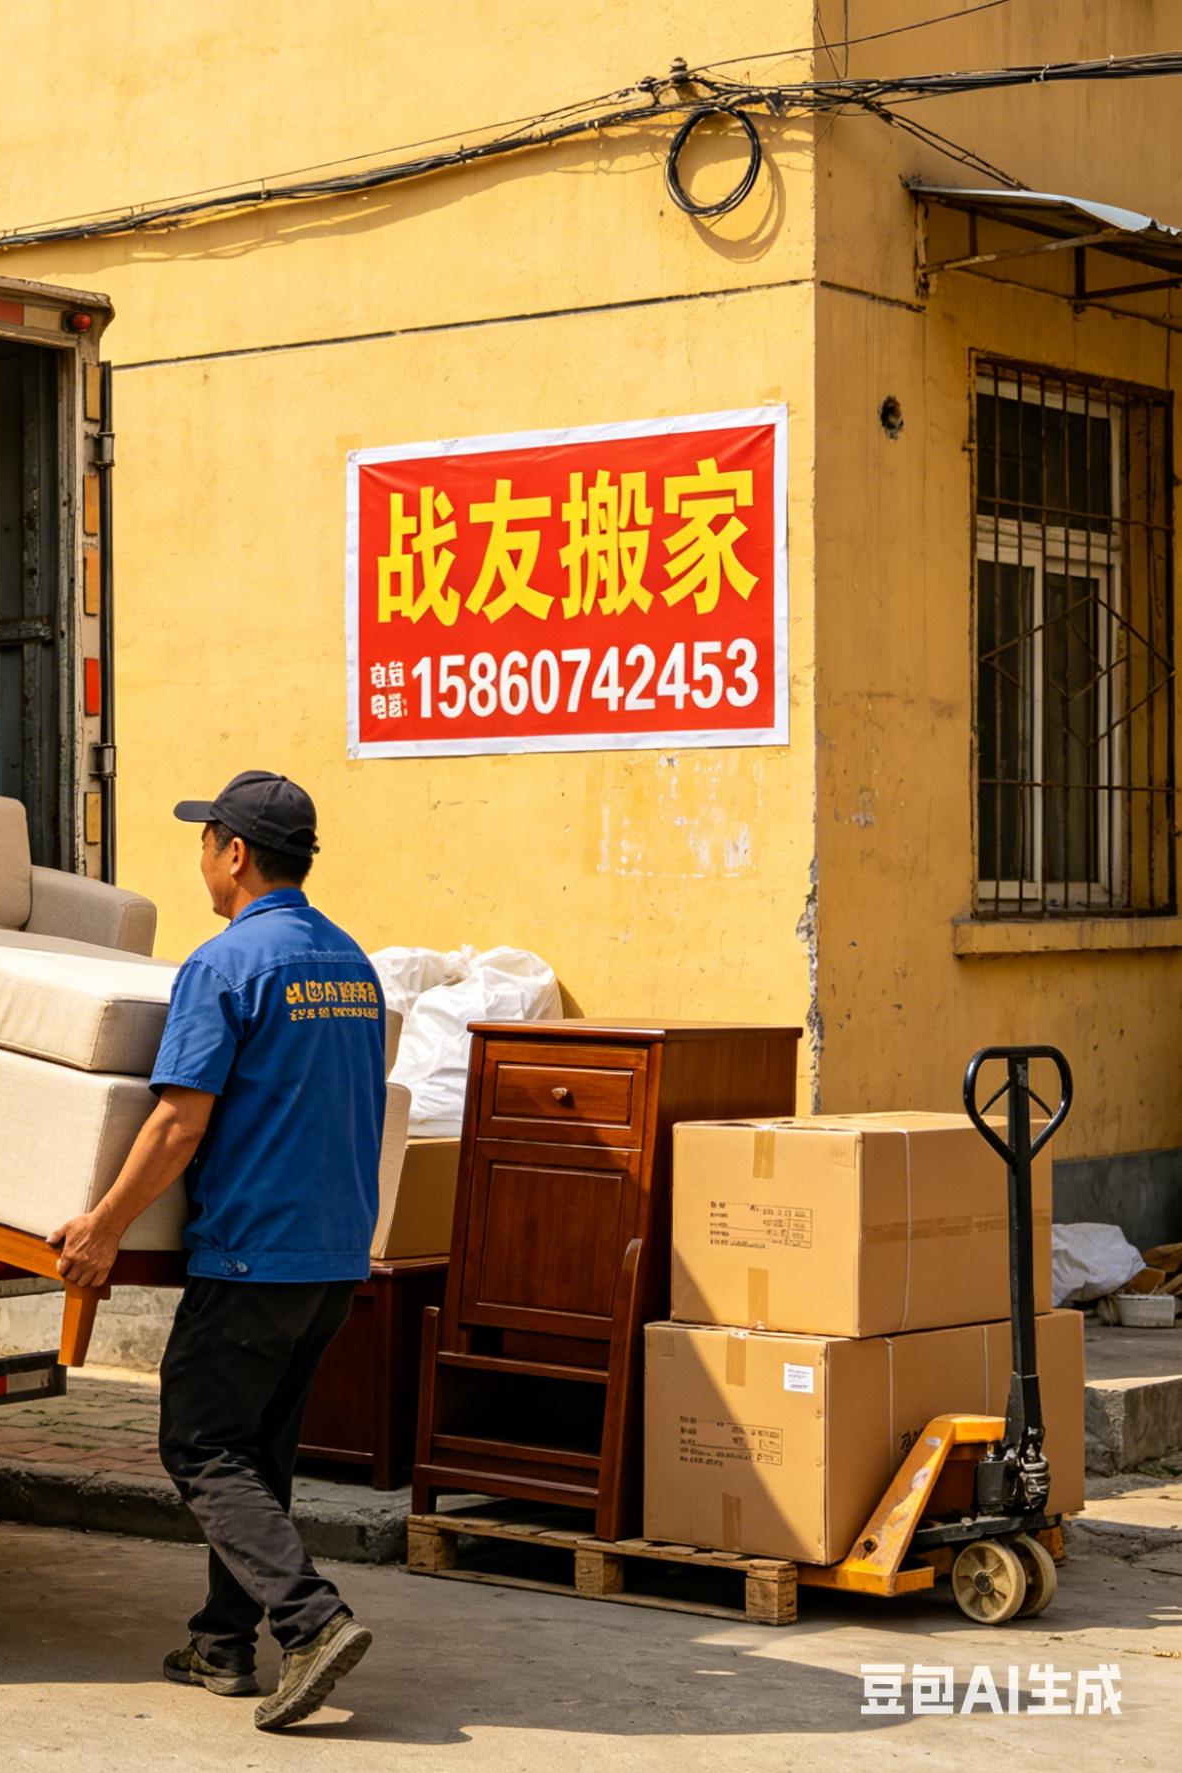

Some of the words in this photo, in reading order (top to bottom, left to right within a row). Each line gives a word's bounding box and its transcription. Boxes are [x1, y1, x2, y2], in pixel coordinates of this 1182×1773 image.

[377, 457, 759, 626] 战友搬家
[411, 637, 759, 719] 15860742453
